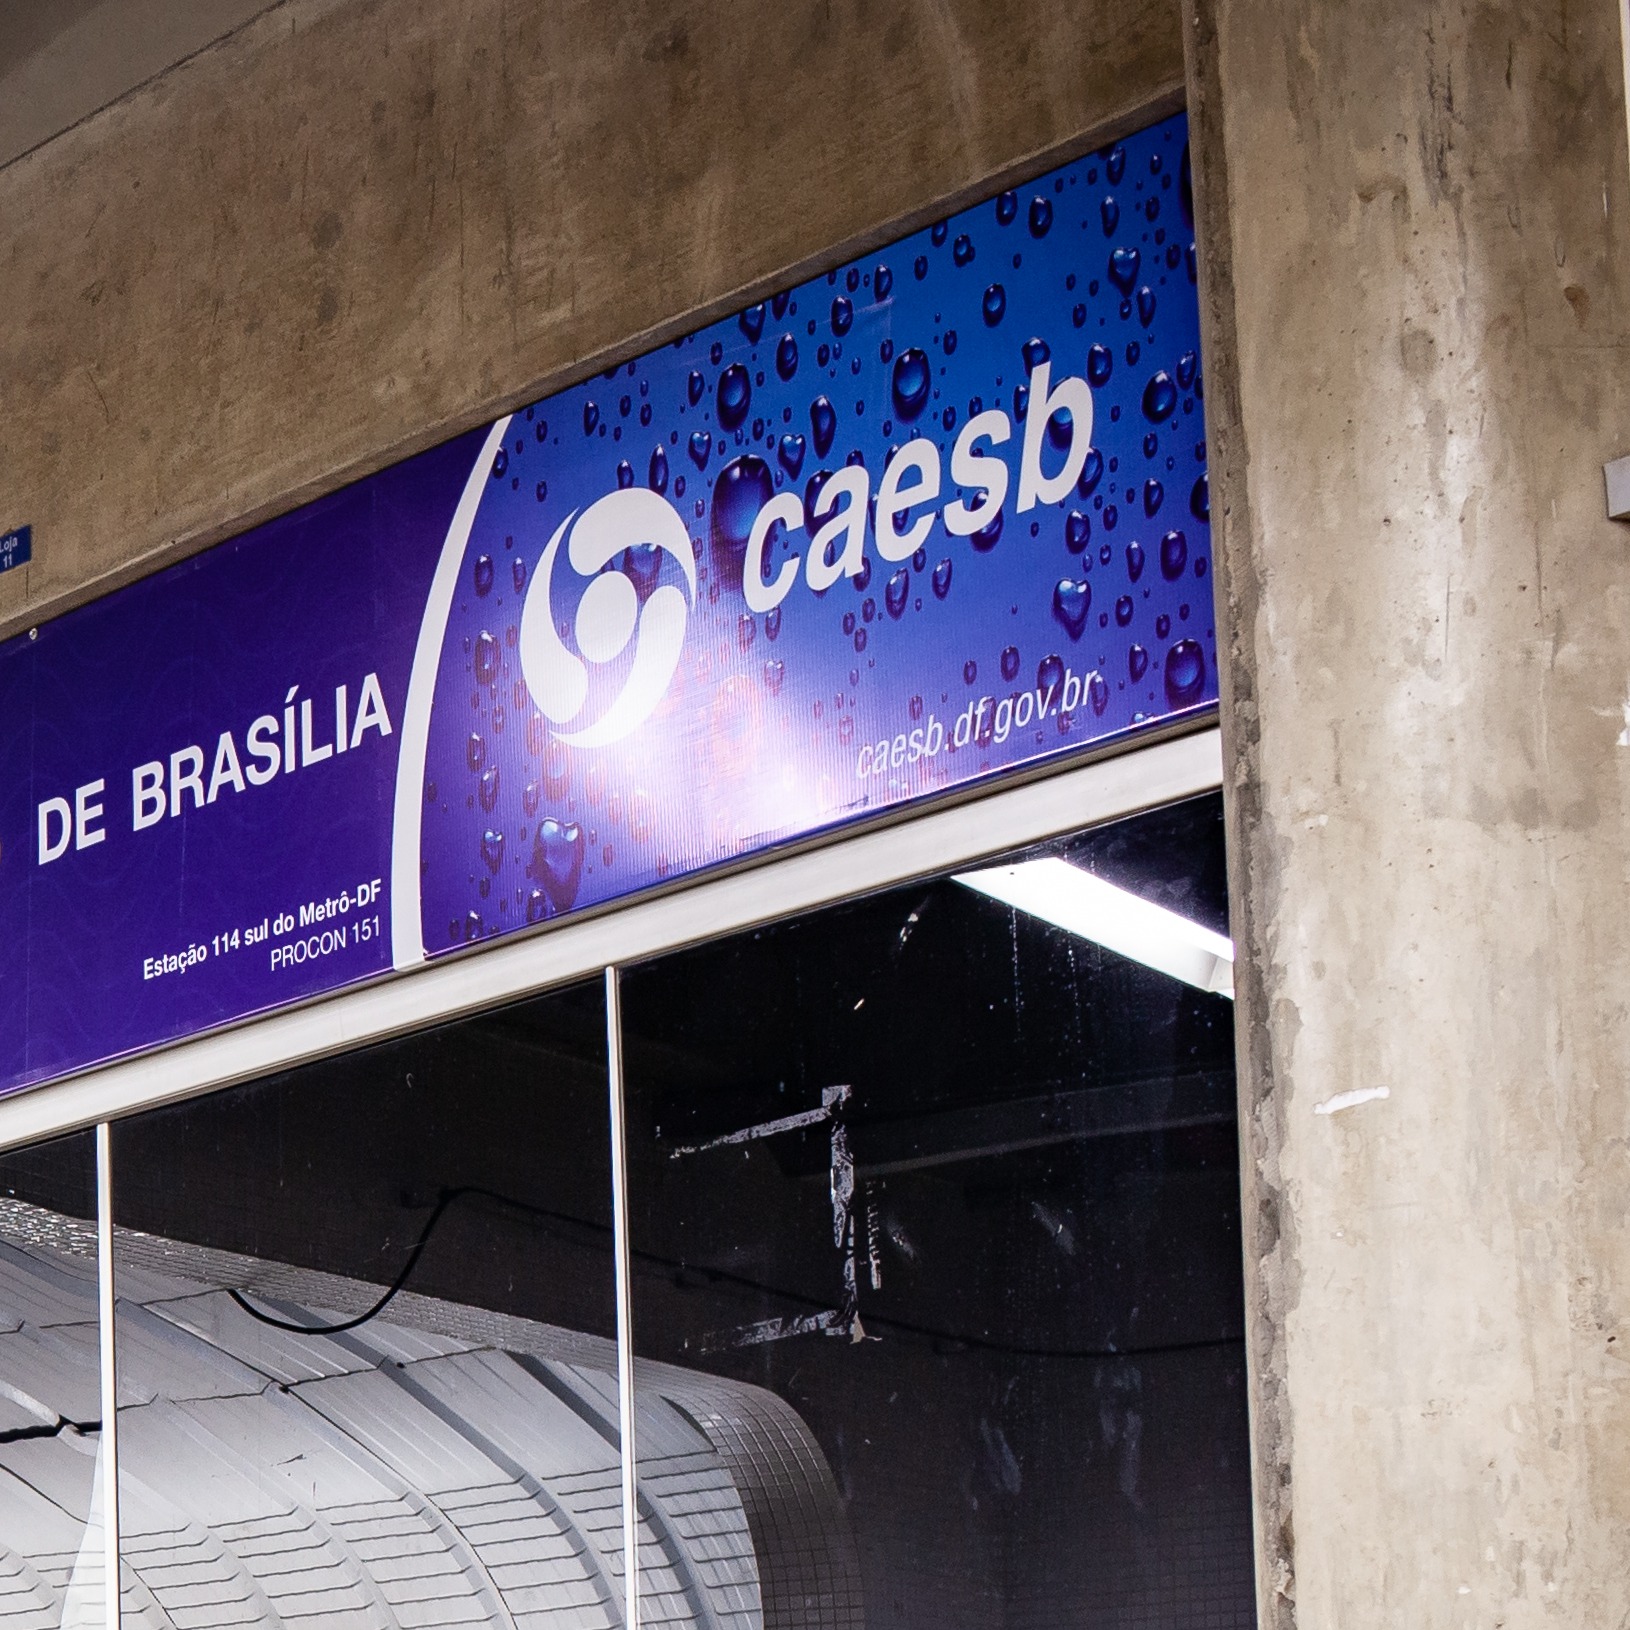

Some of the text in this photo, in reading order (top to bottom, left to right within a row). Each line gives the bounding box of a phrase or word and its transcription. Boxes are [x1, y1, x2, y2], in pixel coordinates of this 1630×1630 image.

[743, 361, 1094, 613] caesb
[3, 554, 13, 568] 11
[38, 778, 105, 866] DE
[132, 672, 393, 832] BRASÍLIA
[856, 668, 1099, 780] caesb.df.gov.br
[143, 878, 382, 980] Estação 114 sul do Metrô-DF
[271, 915, 380, 971] PROCON 151
